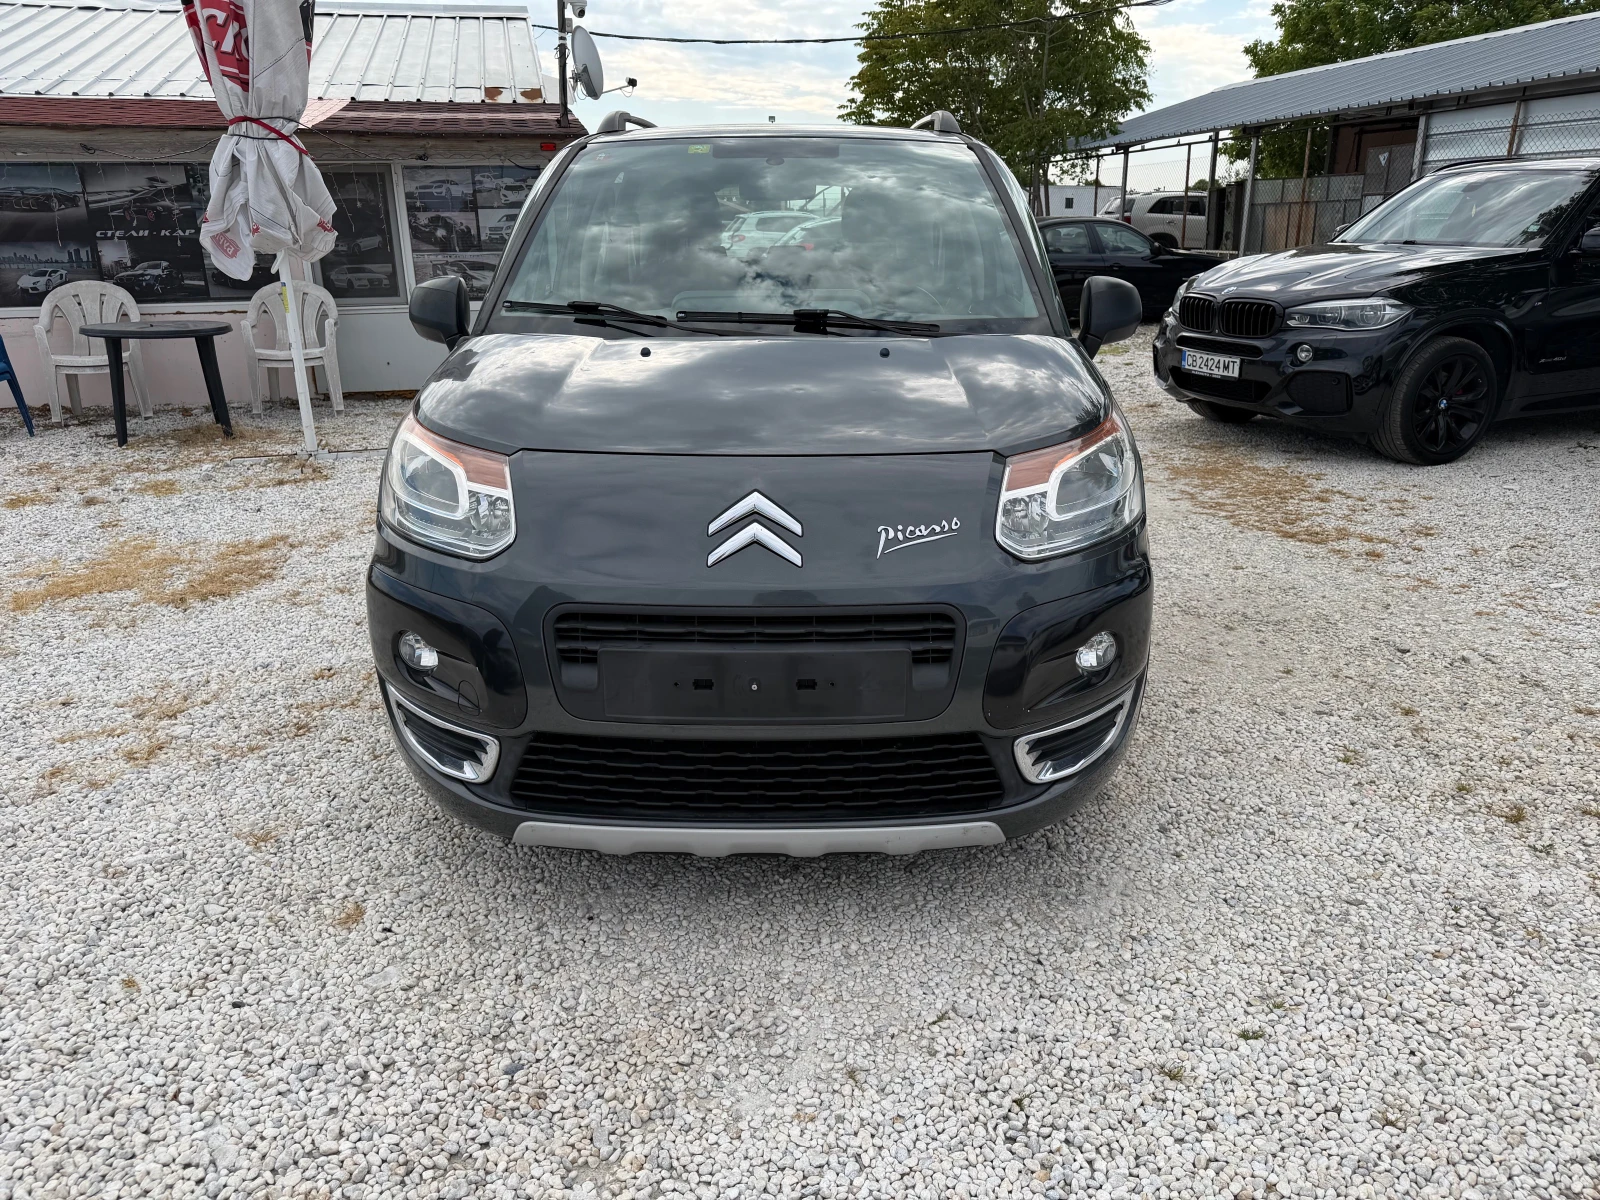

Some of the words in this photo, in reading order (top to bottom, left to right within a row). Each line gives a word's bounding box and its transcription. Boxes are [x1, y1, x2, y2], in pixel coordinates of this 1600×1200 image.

[95, 229, 149, 237] СТЕЛИ
[1198, 356, 1221, 373] 2424
[1222, 359, 1238, 375] MT
[876, 516, 961, 560] Picasso
